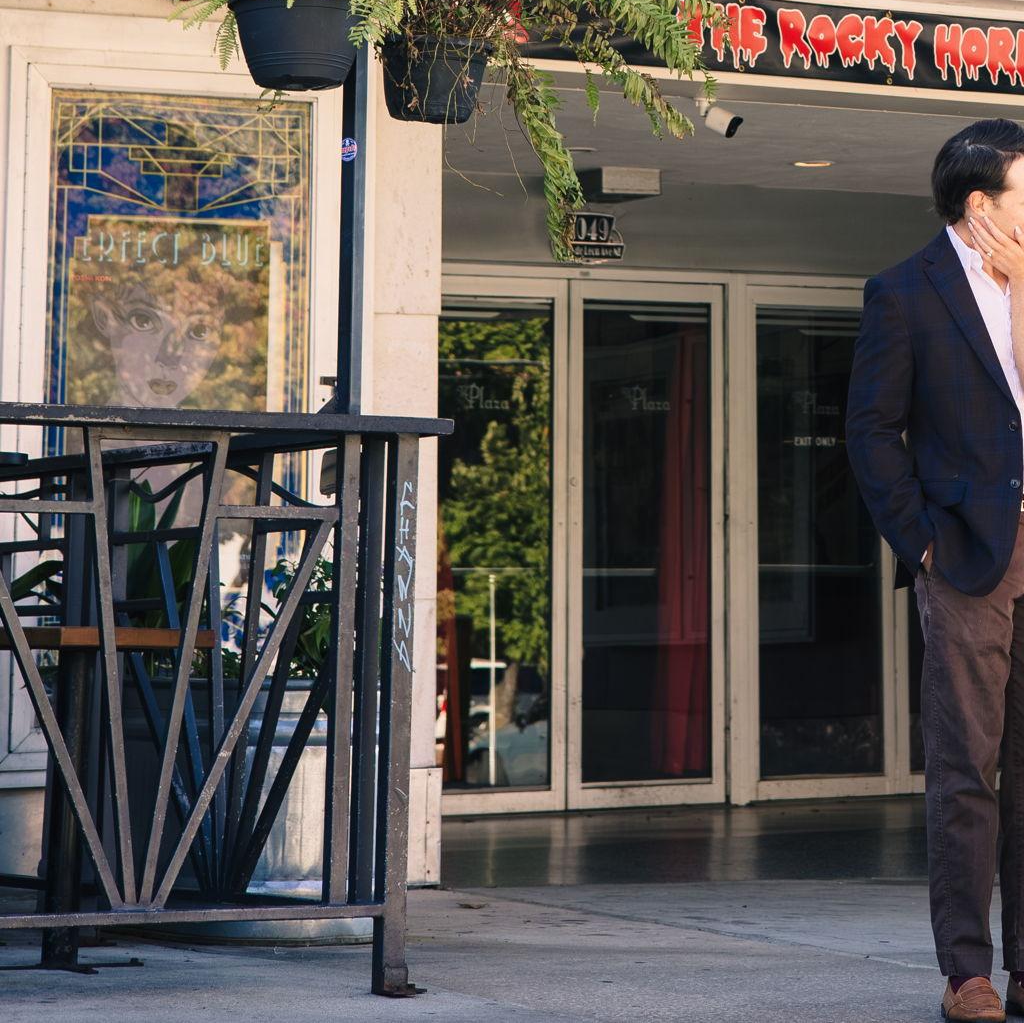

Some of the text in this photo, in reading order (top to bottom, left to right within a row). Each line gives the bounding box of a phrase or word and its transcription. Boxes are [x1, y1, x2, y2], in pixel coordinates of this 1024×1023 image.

[777, 7, 923, 81] ROCKY
[576, 217, 609, 241] 049
[82, 231, 265, 267] ERFECT BLUE
[794, 437, 837, 447] EXIT ONLY
